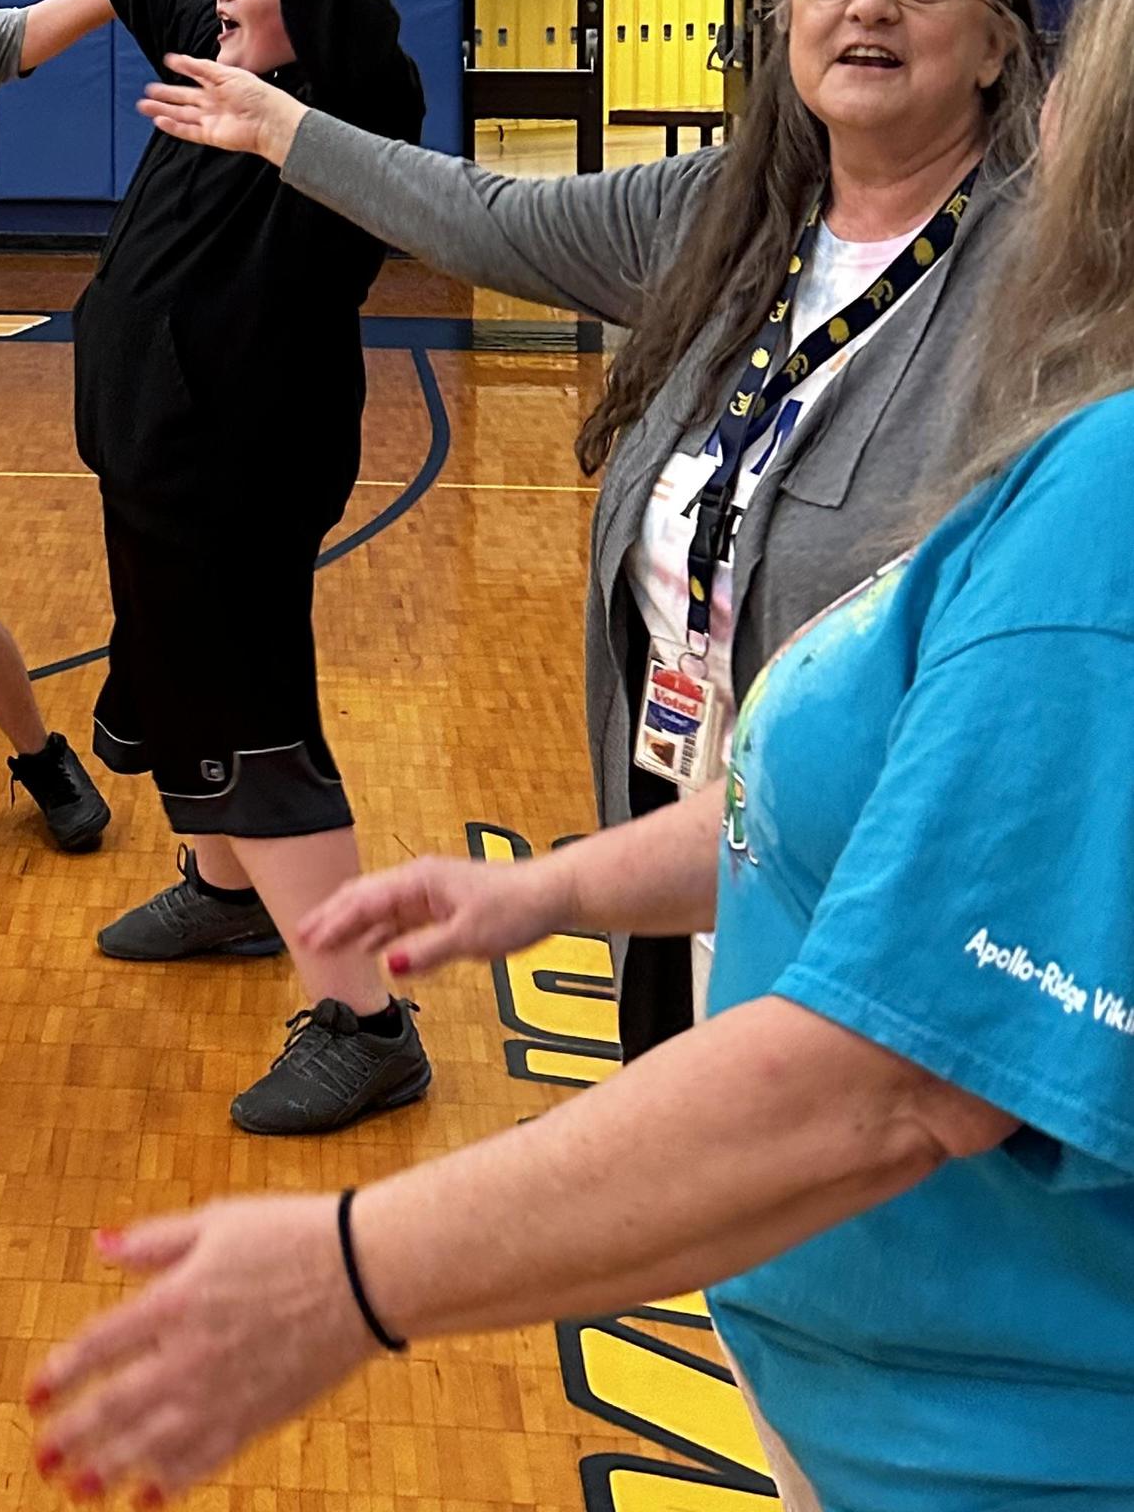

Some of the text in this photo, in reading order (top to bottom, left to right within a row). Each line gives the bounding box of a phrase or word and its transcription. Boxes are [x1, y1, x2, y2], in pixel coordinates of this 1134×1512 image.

[769, 298, 790, 323] Cal
[729, 391, 756, 417] Cal
[653, 687, 698, 717] Voted
[965, 927, 1087, 1014] Apollo-Ridge
